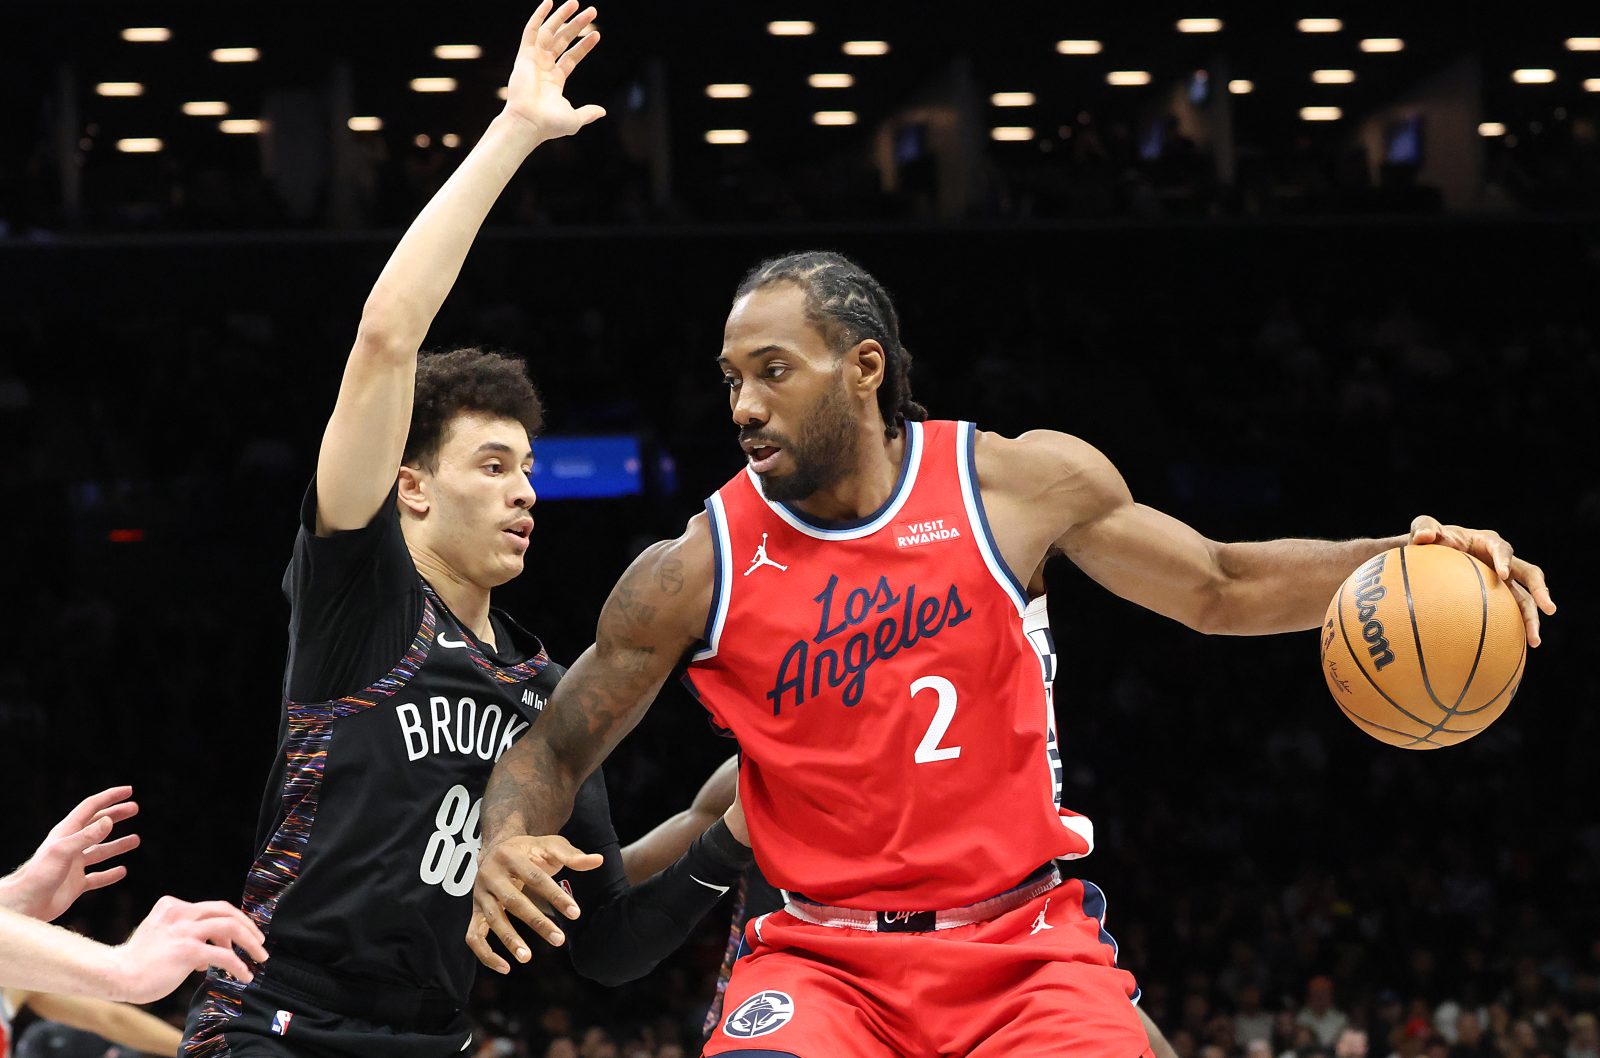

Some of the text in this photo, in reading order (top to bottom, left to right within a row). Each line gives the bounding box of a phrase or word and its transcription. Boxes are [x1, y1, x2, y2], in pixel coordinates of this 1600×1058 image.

[897, 527, 961, 547] RWANDA
[908, 519, 944, 534] VISIT
[813, 574, 901, 645] Los
[1354, 552, 1396, 673] Wilson
[766, 583, 973, 717] Angeles
[395, 695, 530, 764] BROOK
[521, 688, 535, 707] All
[534, 693, 544, 711] In
[909, 675, 962, 765] 2
[419, 784, 484, 897] 88
